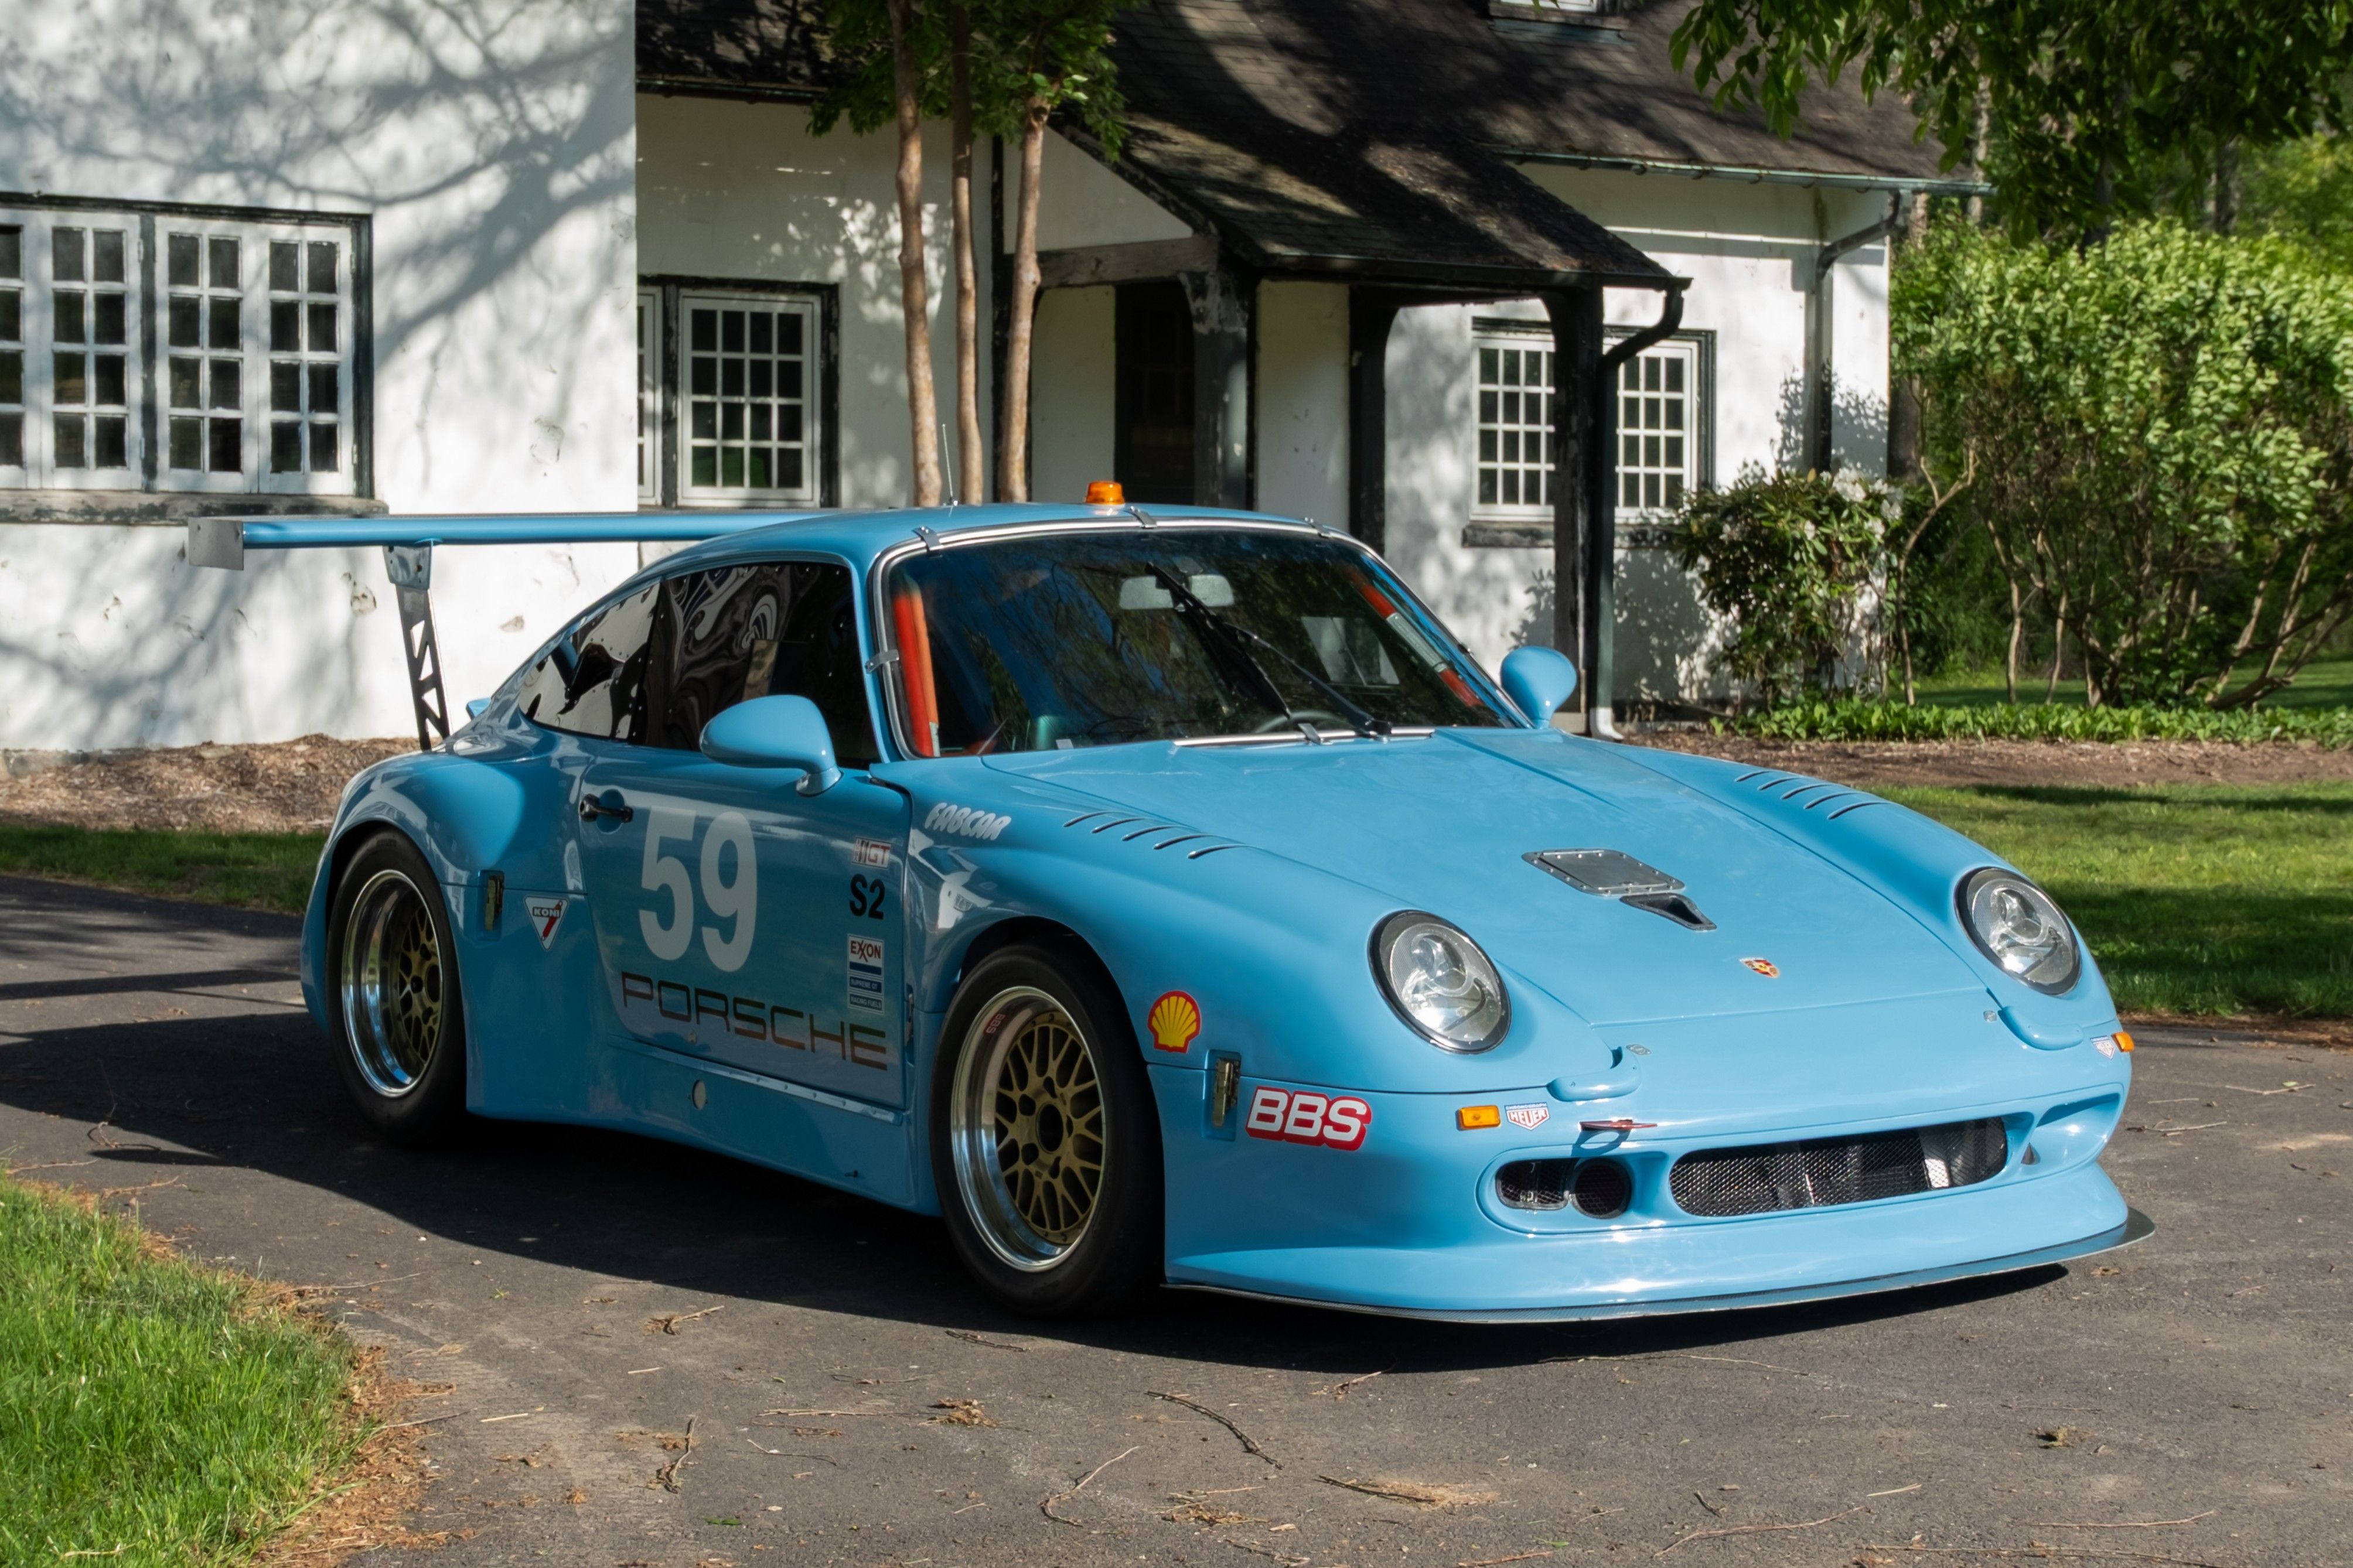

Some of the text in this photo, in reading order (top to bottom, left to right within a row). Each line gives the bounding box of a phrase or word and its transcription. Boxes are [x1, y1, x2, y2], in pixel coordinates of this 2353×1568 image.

[925, 802, 1012, 841] FABCAR
[639, 805, 758, 972] 59
[849, 874, 885, 920] S2
[534, 907, 560, 918] KONI
[850, 940, 881, 962] EXXON
[621, 971, 888, 1071] PORSCHE
[985, 1013, 1006, 1033] BBS
[1247, 1088, 1367, 1142] BBS
[1509, 1109, 1547, 1126] HEUER
